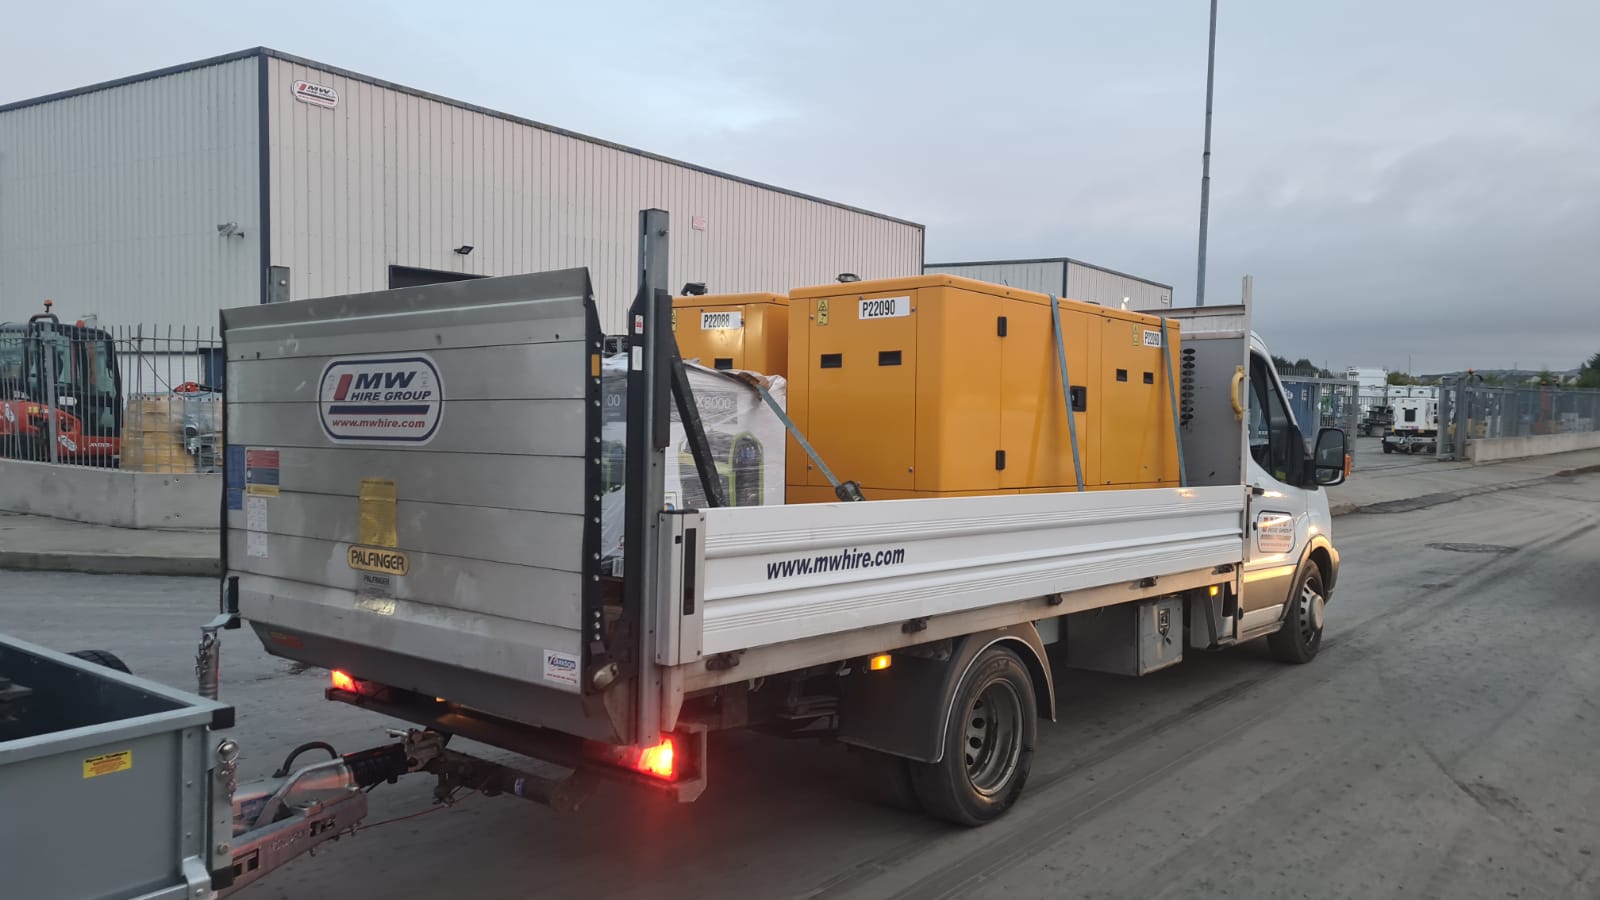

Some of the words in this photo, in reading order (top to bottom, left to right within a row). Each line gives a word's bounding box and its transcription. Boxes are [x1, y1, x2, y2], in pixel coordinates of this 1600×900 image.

[862, 299, 896, 317] P22090
[703, 313, 730, 328] P22088
[350, 391, 381, 401] HIRE
[384, 391, 432, 401] GROUP
[332, 418, 426, 429] www.mwhire.com
[350, 549, 405, 571] PALFINGER
[766, 547, 906, 580] www.mwhire.com
